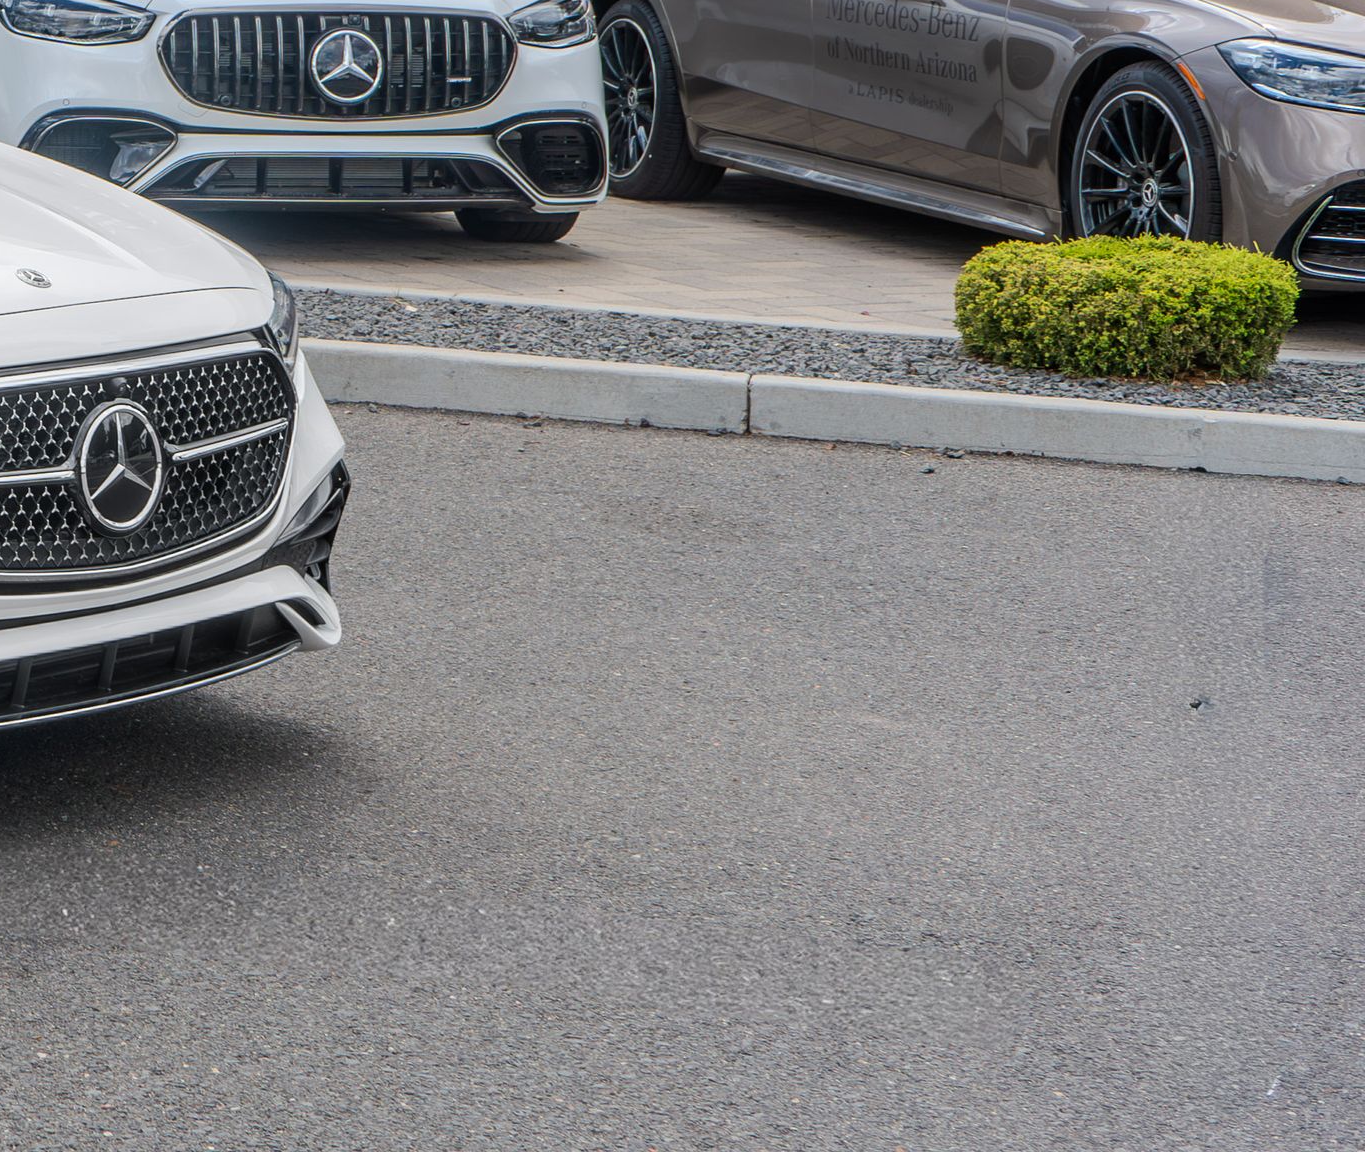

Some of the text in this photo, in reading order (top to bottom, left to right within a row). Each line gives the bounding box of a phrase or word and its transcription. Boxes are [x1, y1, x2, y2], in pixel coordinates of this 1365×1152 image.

[827, 36, 978, 83] of Northern Arizona
[857, 82, 905, 104] LAPIS
[908, 94, 954, 117] dealership
